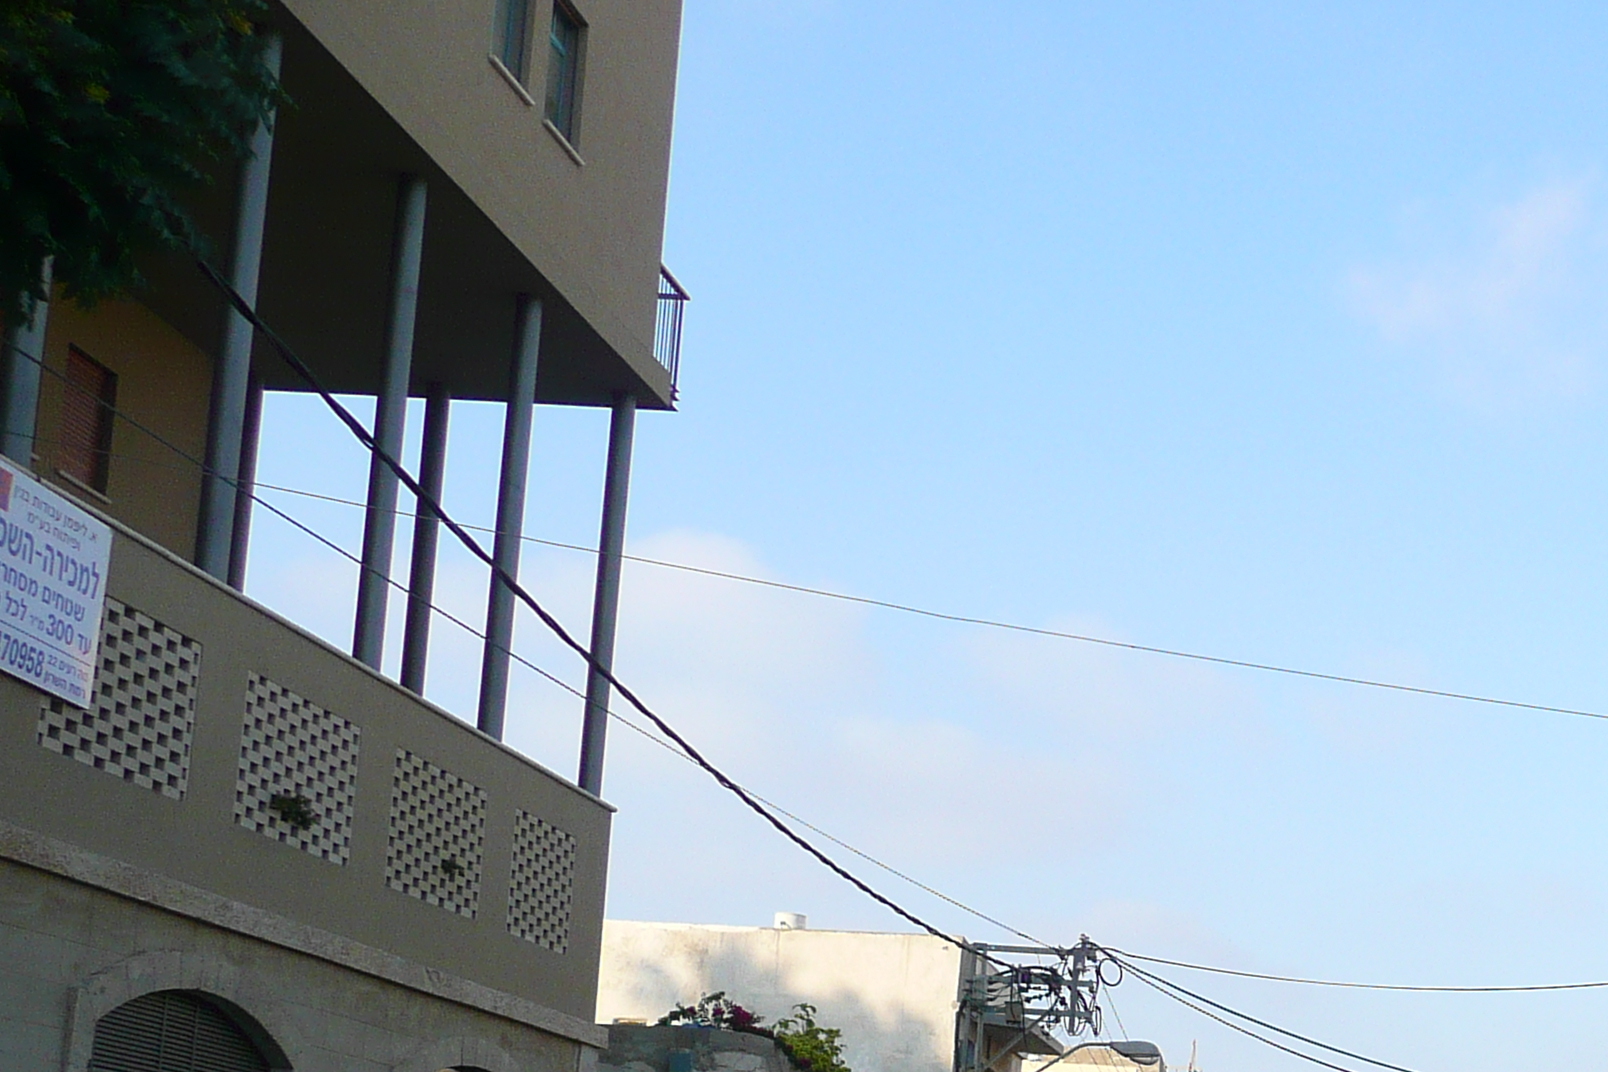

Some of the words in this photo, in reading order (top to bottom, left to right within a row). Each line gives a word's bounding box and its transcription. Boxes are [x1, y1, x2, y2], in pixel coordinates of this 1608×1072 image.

[6, 590, 27, 621] לכל
[42, 585, 86, 622] שטחים
[46, 614, 74, 645] 300
[78, 633, 92, 655] עד
[0, 630, 45, 678] 70958
